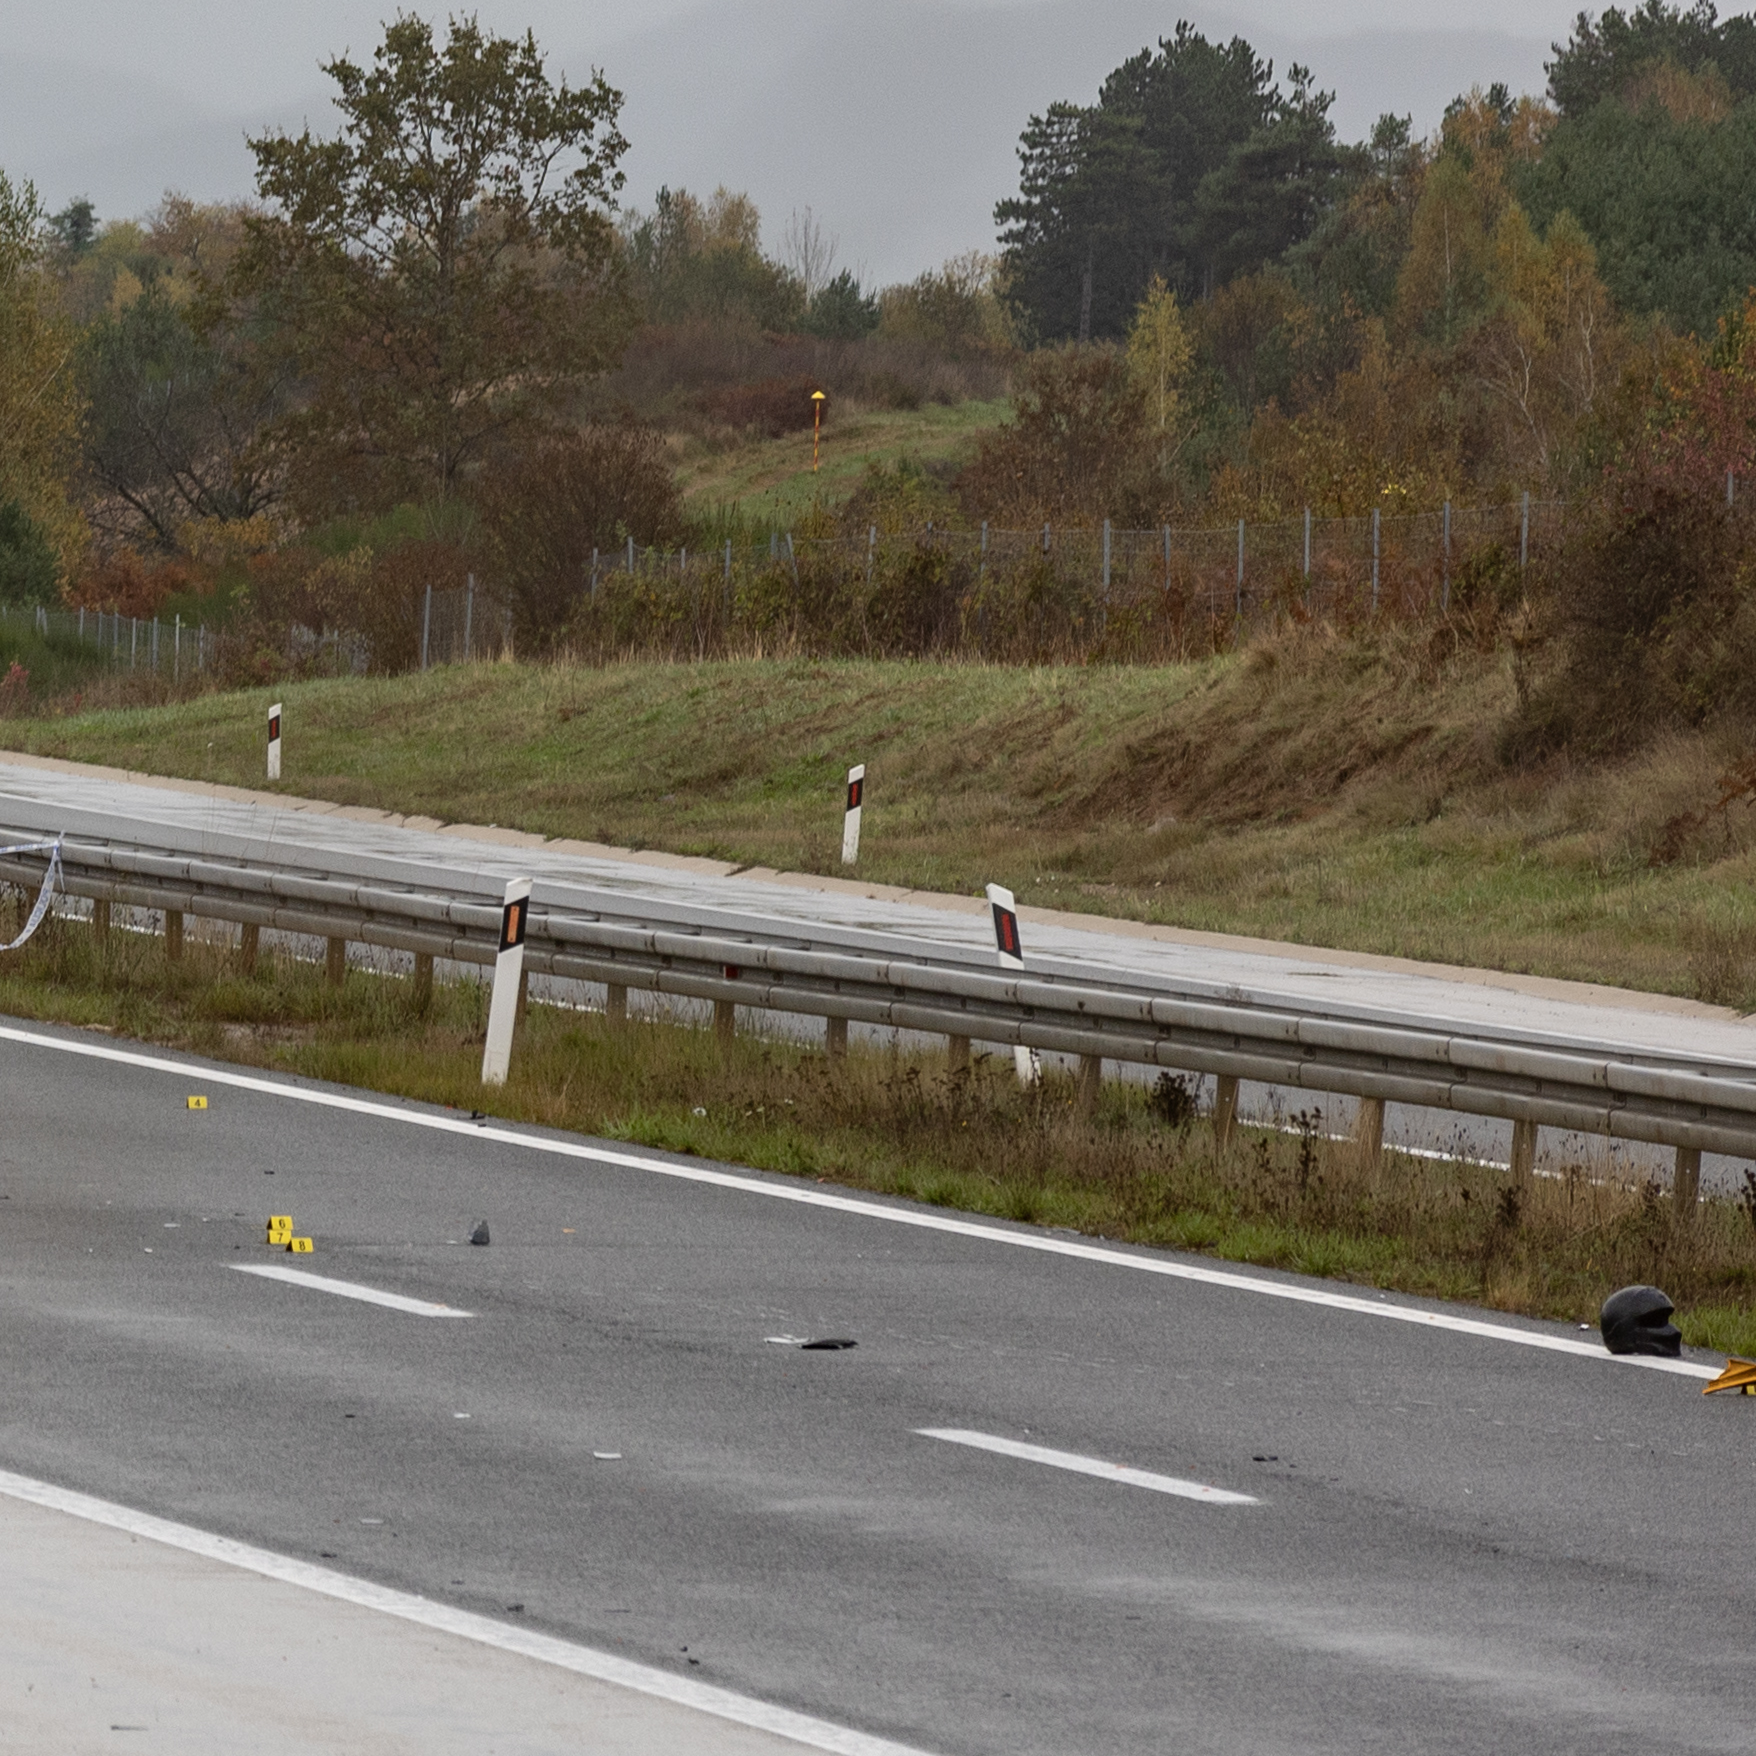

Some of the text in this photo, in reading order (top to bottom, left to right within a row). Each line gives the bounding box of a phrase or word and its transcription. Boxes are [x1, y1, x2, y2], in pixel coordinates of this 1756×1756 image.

[194, 1098, 201, 1107] 4
[278, 1218, 286, 1229] 6
[277, 1232, 284, 1243] 7
[299, 1240, 306, 1251] 8
